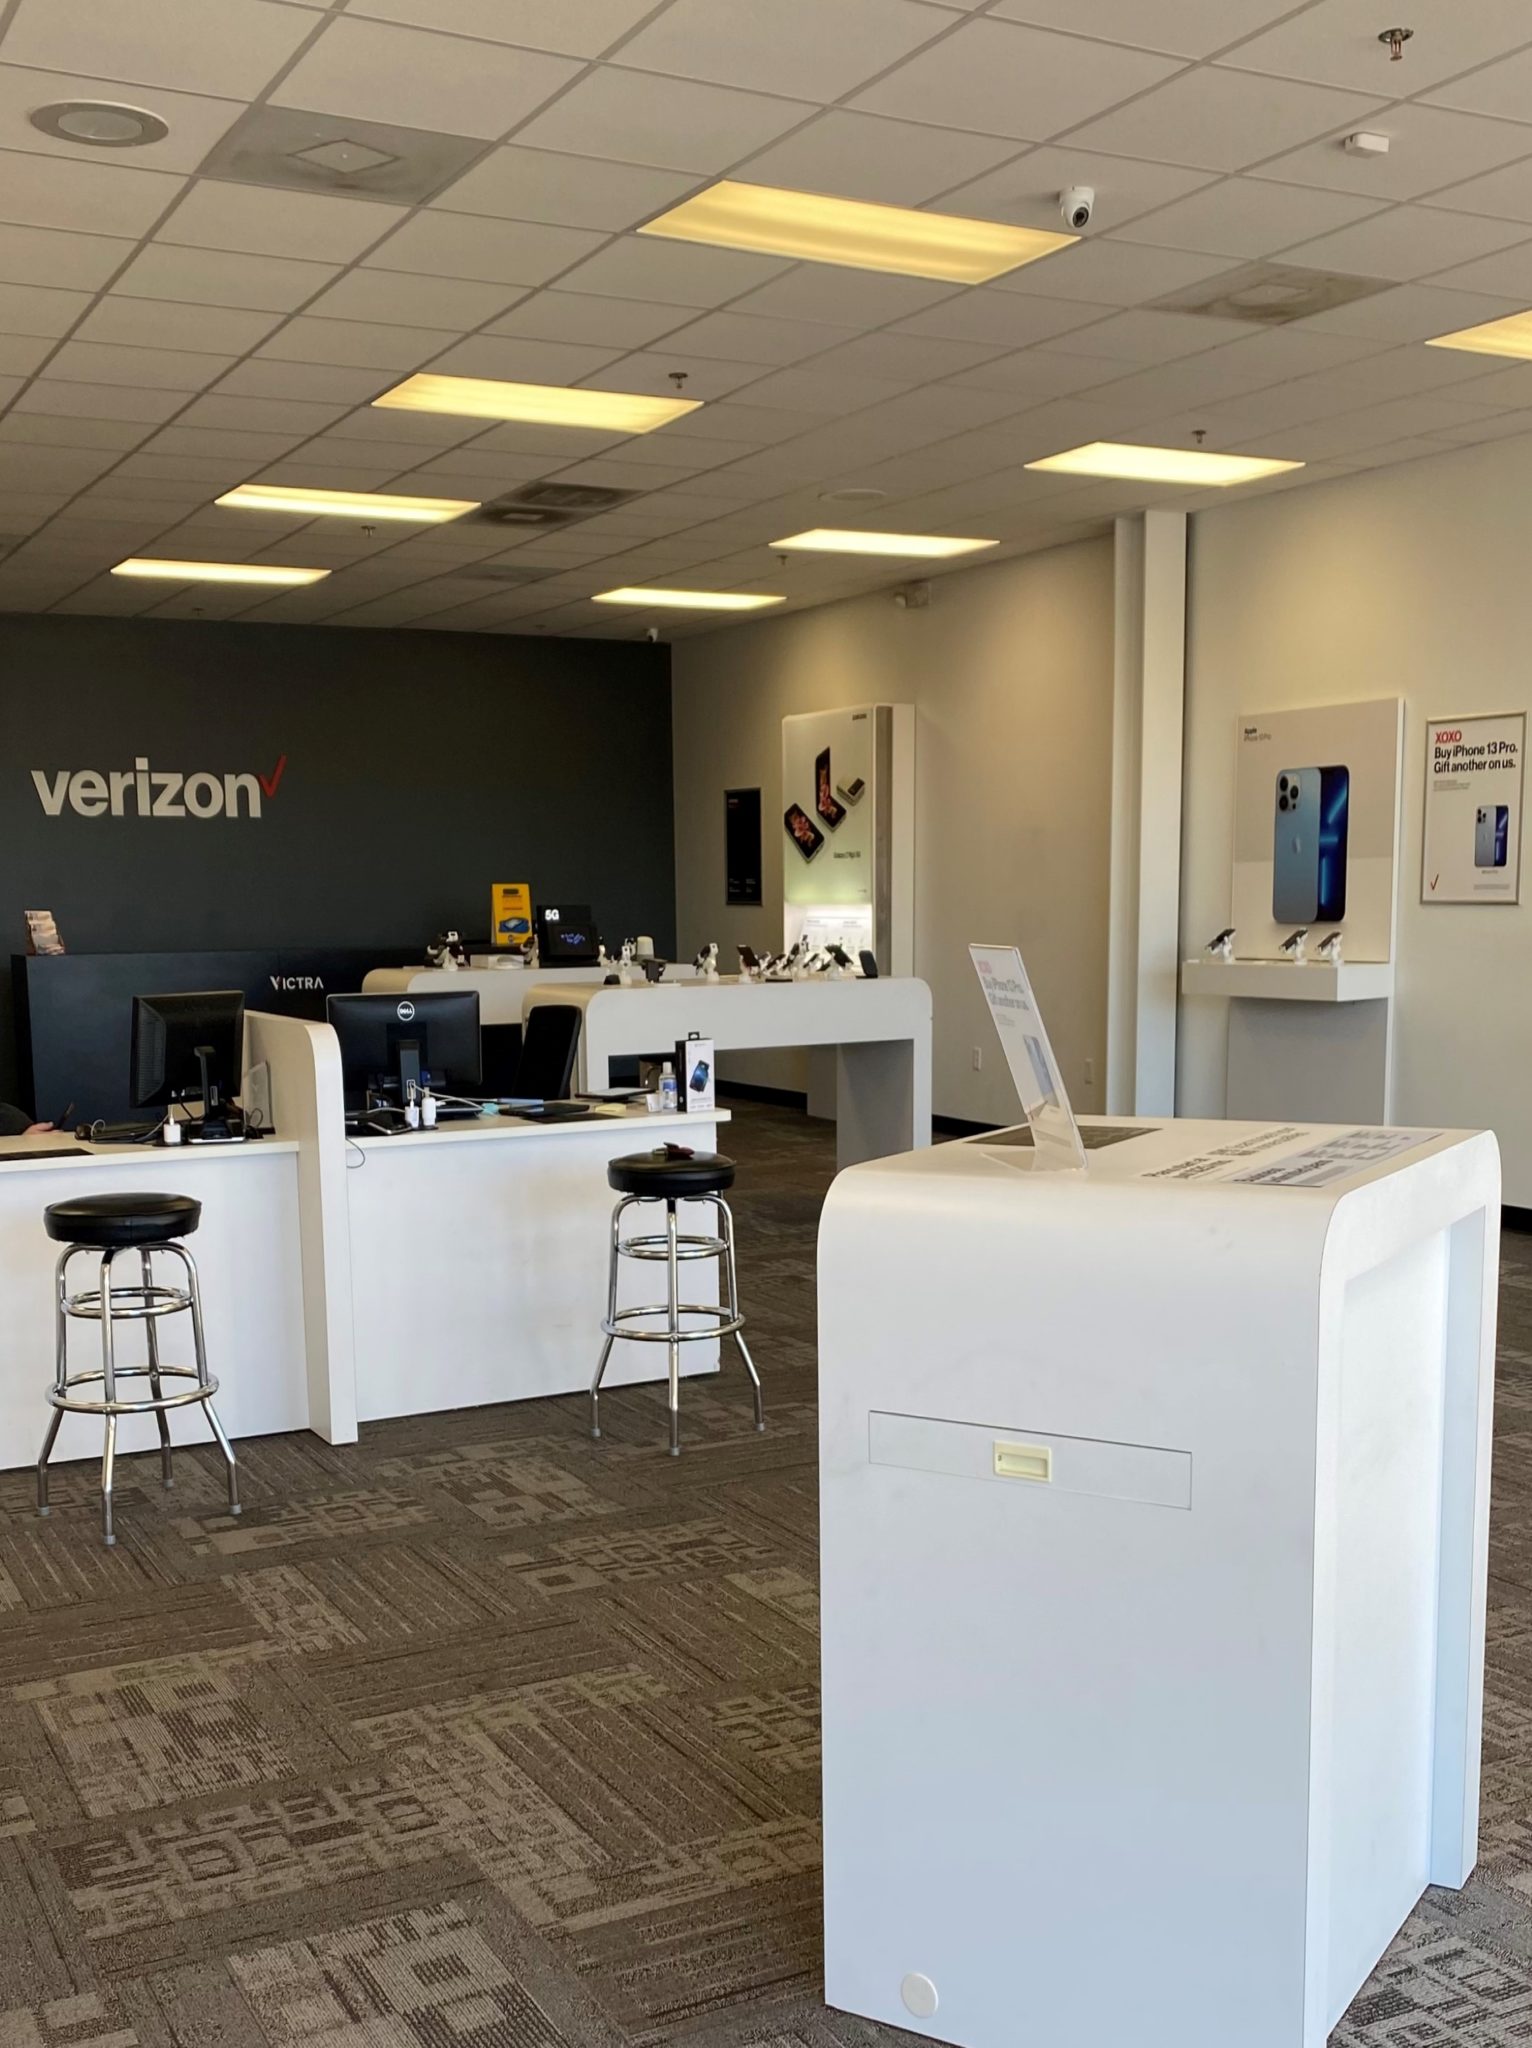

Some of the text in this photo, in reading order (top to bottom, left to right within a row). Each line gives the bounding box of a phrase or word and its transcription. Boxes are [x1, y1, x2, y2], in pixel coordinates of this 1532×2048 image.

[1435, 730, 1462, 744] XOXO
[1434, 741, 1518, 760] Buy iPhone 13 Pro.
[1434, 758, 1516, 774] Gift another on us.
[30, 757, 262, 819] verizon
[544, 908, 560, 921] 5G
[270, 975, 324, 991] VICTRA
